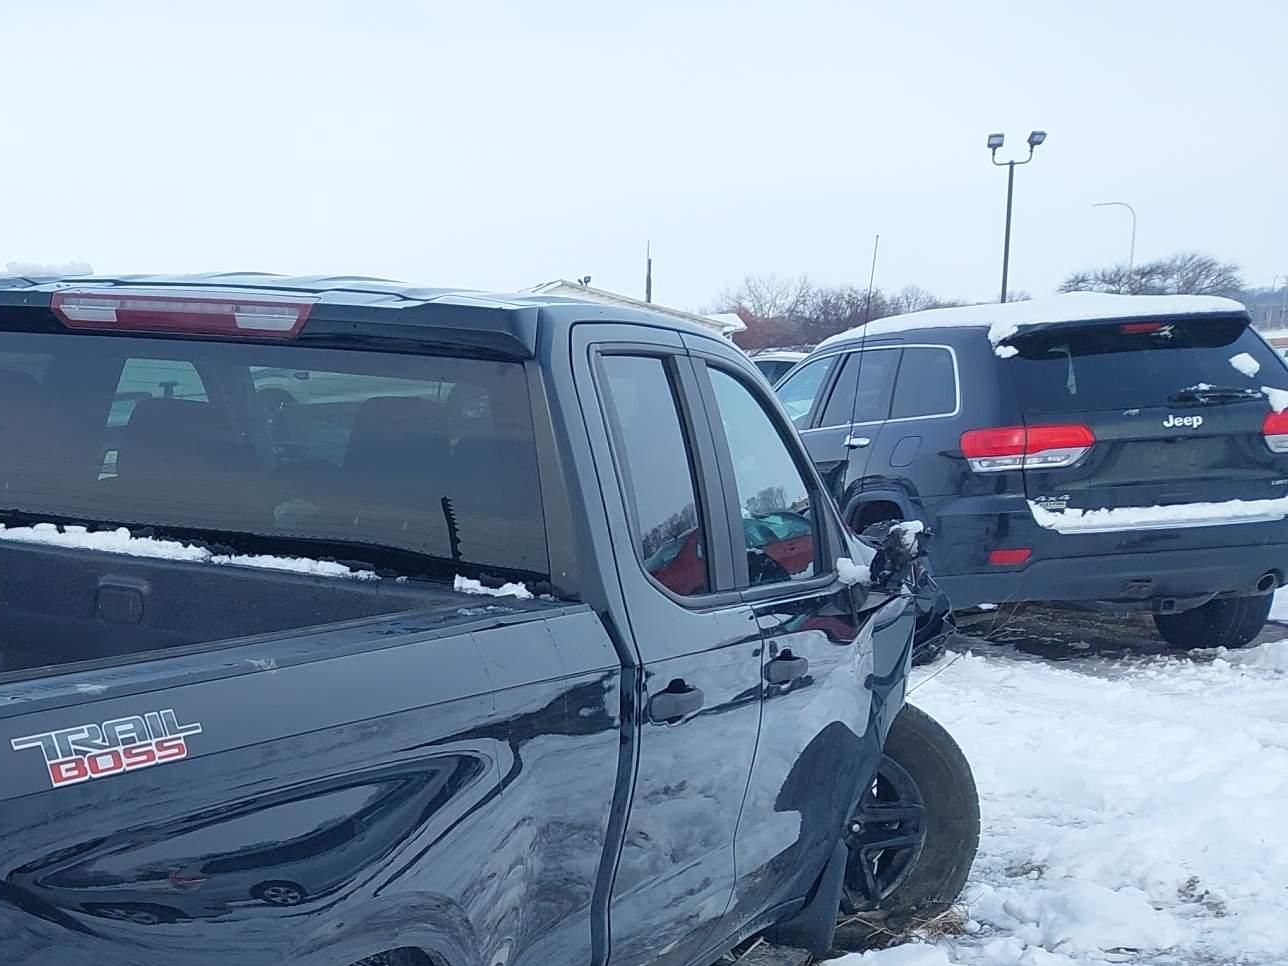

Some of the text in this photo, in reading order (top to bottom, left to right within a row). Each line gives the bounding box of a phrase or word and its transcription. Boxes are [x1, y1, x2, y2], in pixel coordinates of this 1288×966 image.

[1162, 414, 1203, 429] Jeep
[11, 709, 202, 762] TRAIL
[48, 736, 187, 788] BOSS
